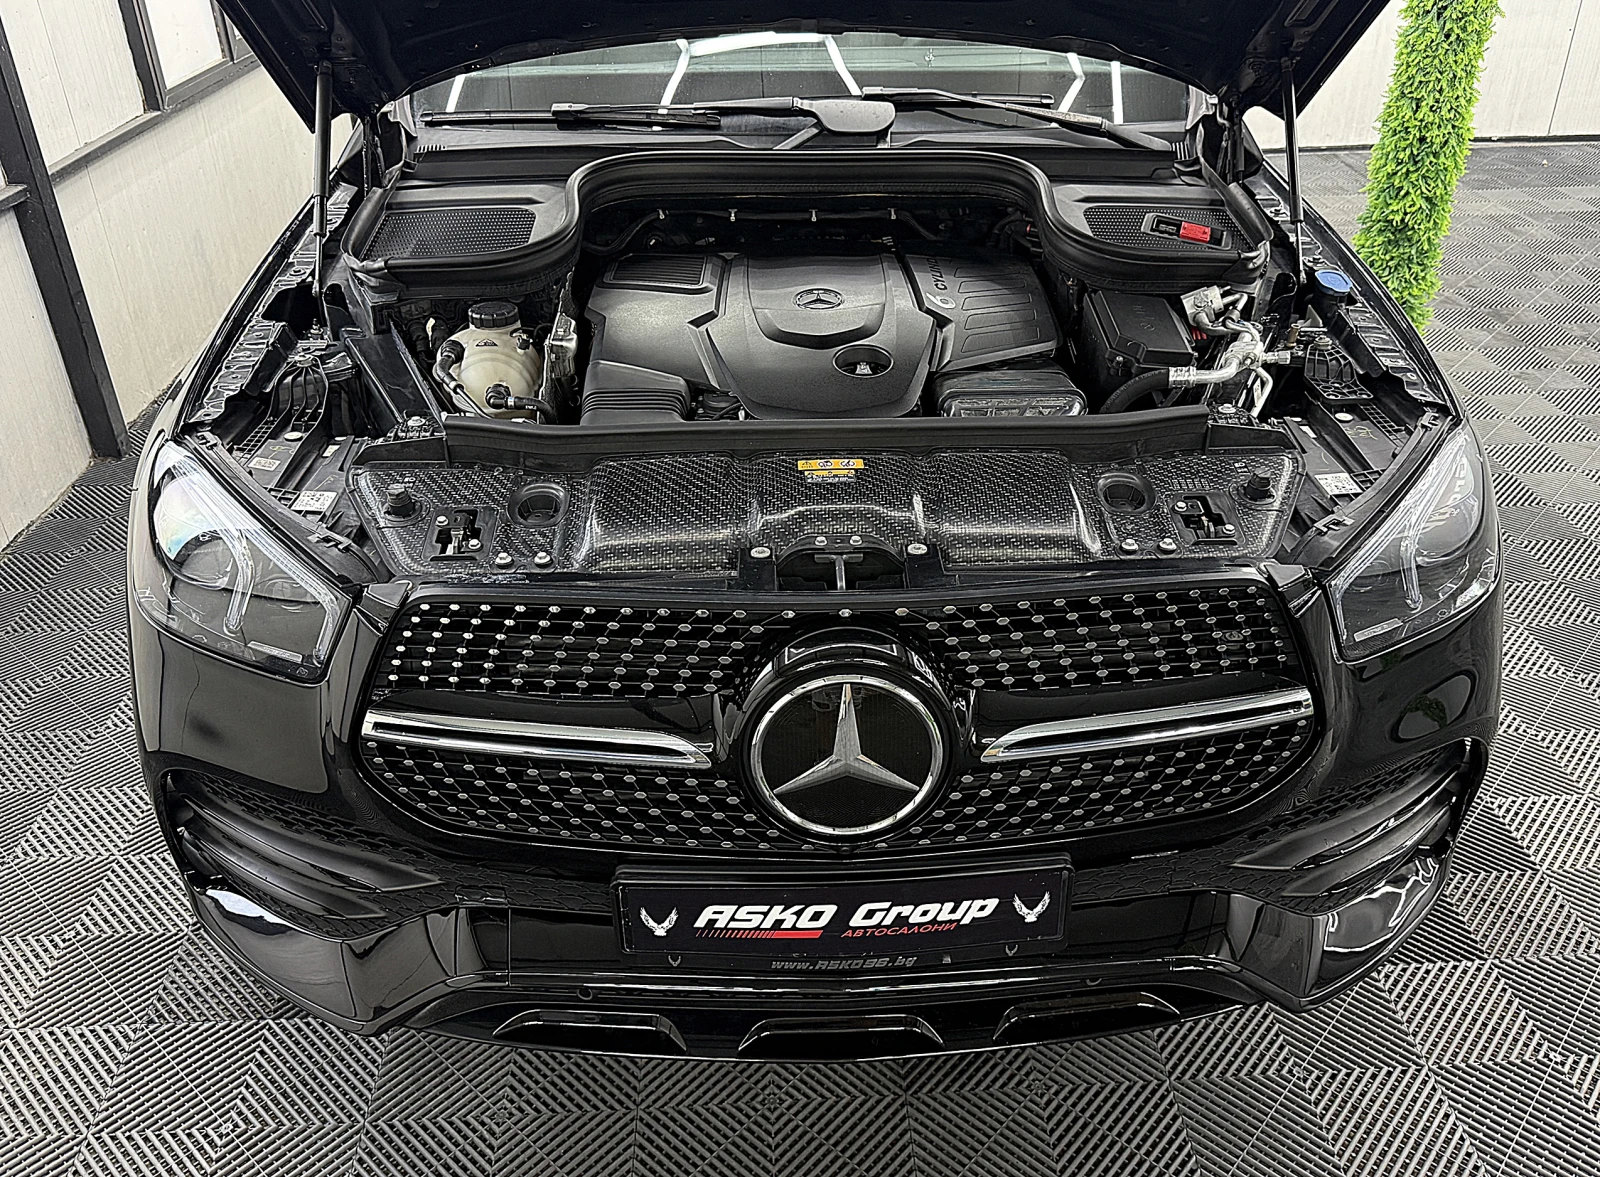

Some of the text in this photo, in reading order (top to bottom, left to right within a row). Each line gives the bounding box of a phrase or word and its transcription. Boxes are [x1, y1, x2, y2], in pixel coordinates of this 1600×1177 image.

[926, 292, 956, 309] 6
[693, 897, 999, 930] ASKO Group
[840, 922, 958, 938] АВТОСАЛОНИ
